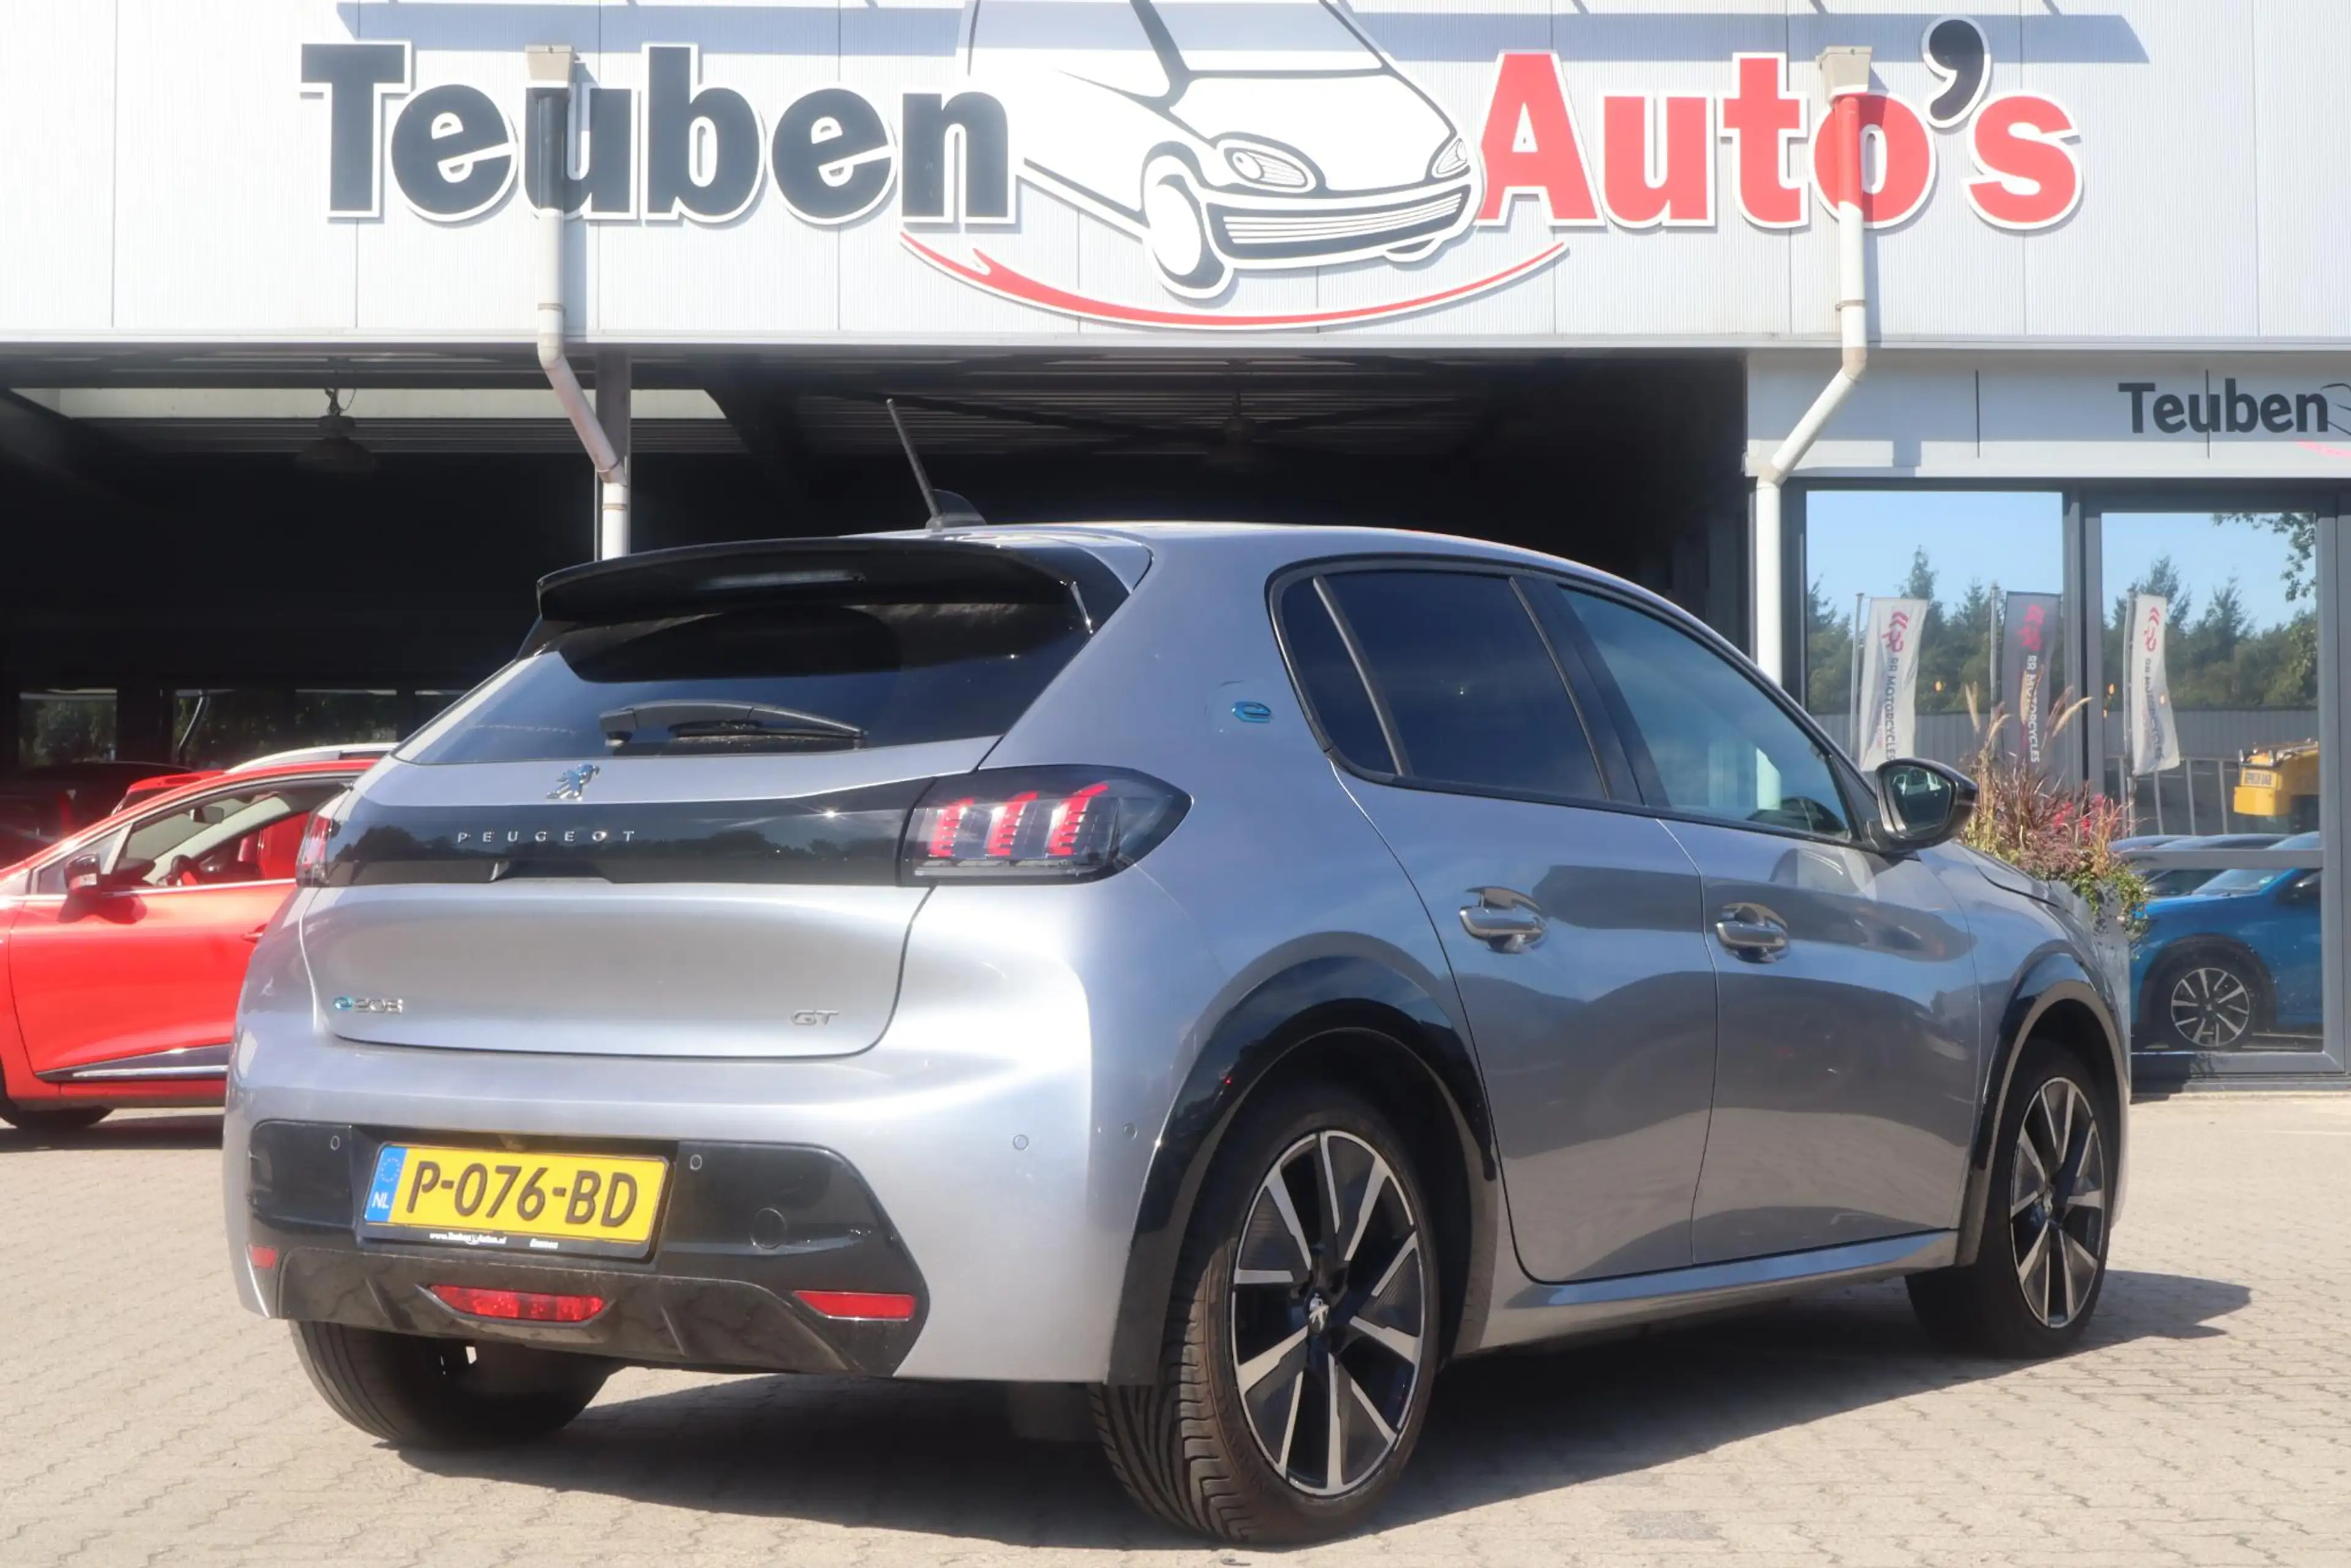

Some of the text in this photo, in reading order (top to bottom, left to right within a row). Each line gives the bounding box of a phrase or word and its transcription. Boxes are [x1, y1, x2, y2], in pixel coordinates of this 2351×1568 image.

[301, 19, 2077, 223] Teuben Auto's
[2118, 377, 2329, 433] Teuben
[457, 830, 635, 843] PEUGEOT
[790, 1010, 840, 1026] GT
[371, 1191, 390, 1209] NL
[406, 1160, 638, 1228] P-076-BD
